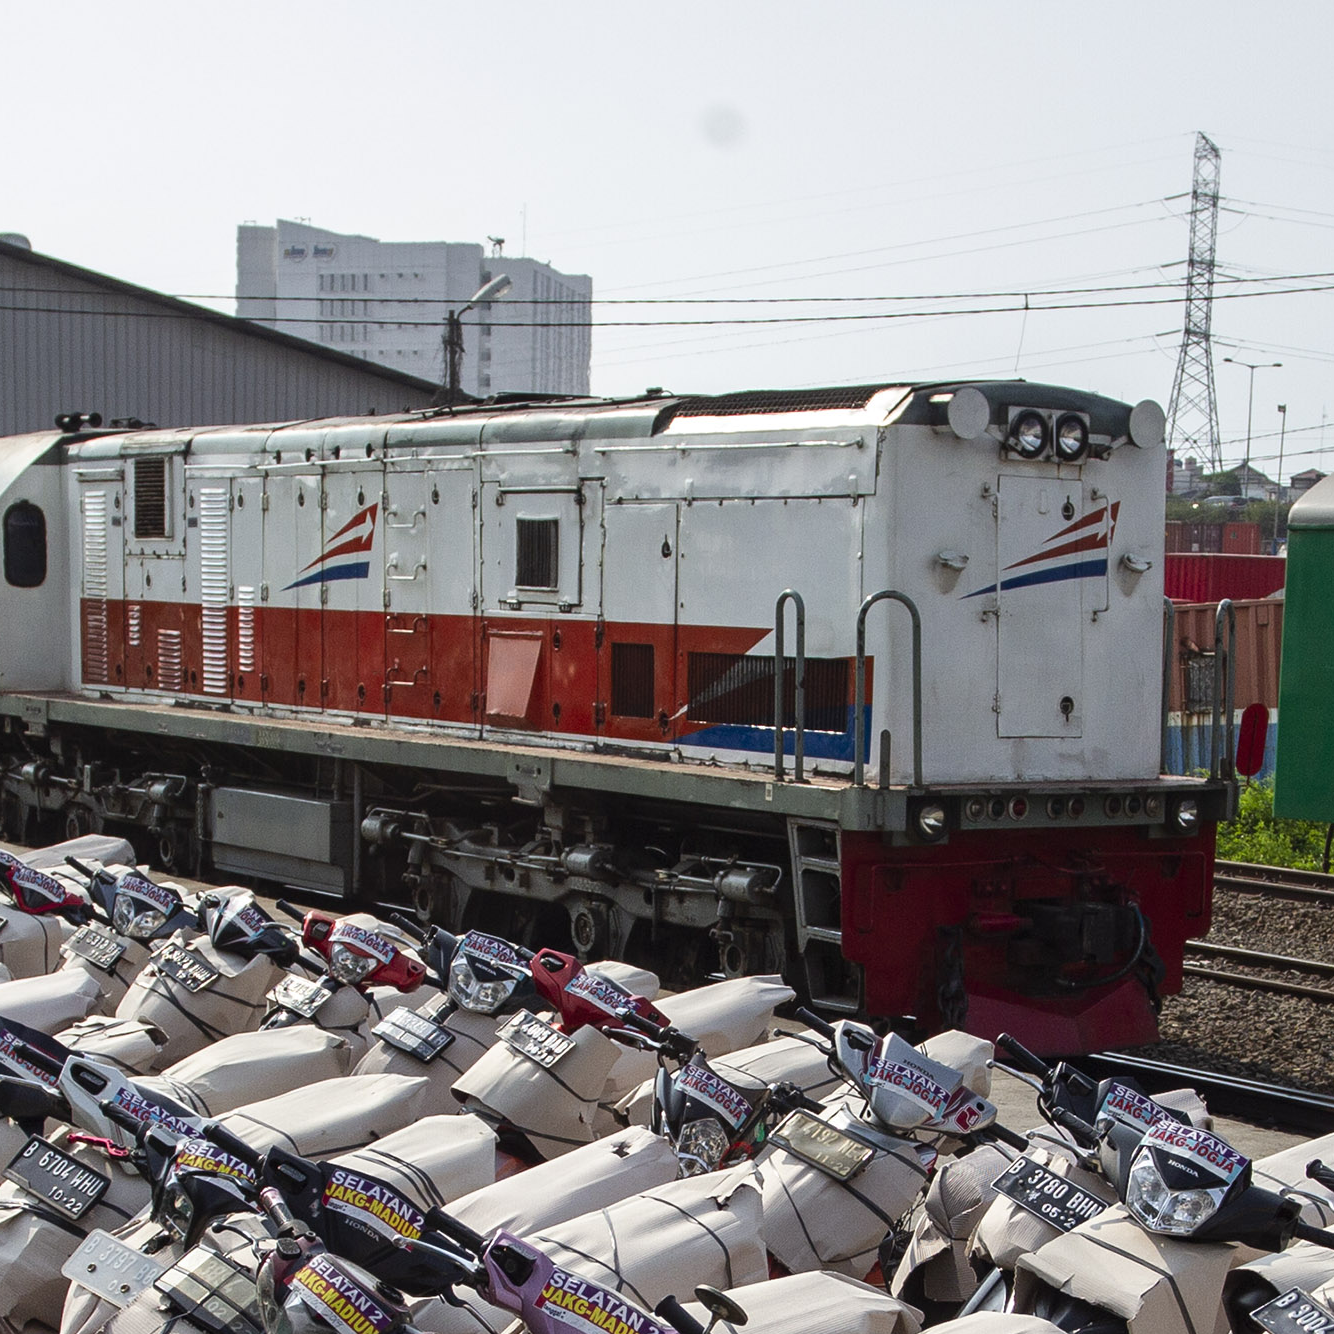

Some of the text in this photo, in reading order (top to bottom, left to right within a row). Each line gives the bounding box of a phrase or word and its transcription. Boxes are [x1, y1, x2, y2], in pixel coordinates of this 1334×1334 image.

[578, 973, 628, 1003] SELATAN
[686, 1065, 750, 1111] SELATAN 2
[869, 1065, 943, 1111] JAKG-JOGJA
[874, 1058, 946, 1099] SELATAN 2
[902, 1058, 936, 1080] HONDA
[121, 1089, 189, 1134] SELATAN
[189, 1128, 202, 1140] 2
[679, 1075, 743, 1122] JAKG-JOGJA
[808, 1121, 839, 1146] 4192
[1148, 1126, 1235, 1175] JAKG-JOGJA
[1158, 1119, 1241, 1162] SELATAN 2
[22, 1140, 105, 1198] B 6704 WHU
[1008, 1160, 1027, 1175] B
[1027, 1169, 1068, 1200] 3780
[1166, 1158, 1199, 1178] HONDA
[324, 1182, 422, 1240] JAKG-MADIUN
[332, 1170, 426, 1231] SELATAN 2
[344, 1217, 380, 1243] HONDA
[83, 1235, 134, 1275] B 3797
[308, 1256, 371, 1313] SELATAN
[368, 1310, 384, 1324] 2
[549, 1272, 645, 1332] SELATAN
[1274, 1292, 1299, 1309] B
